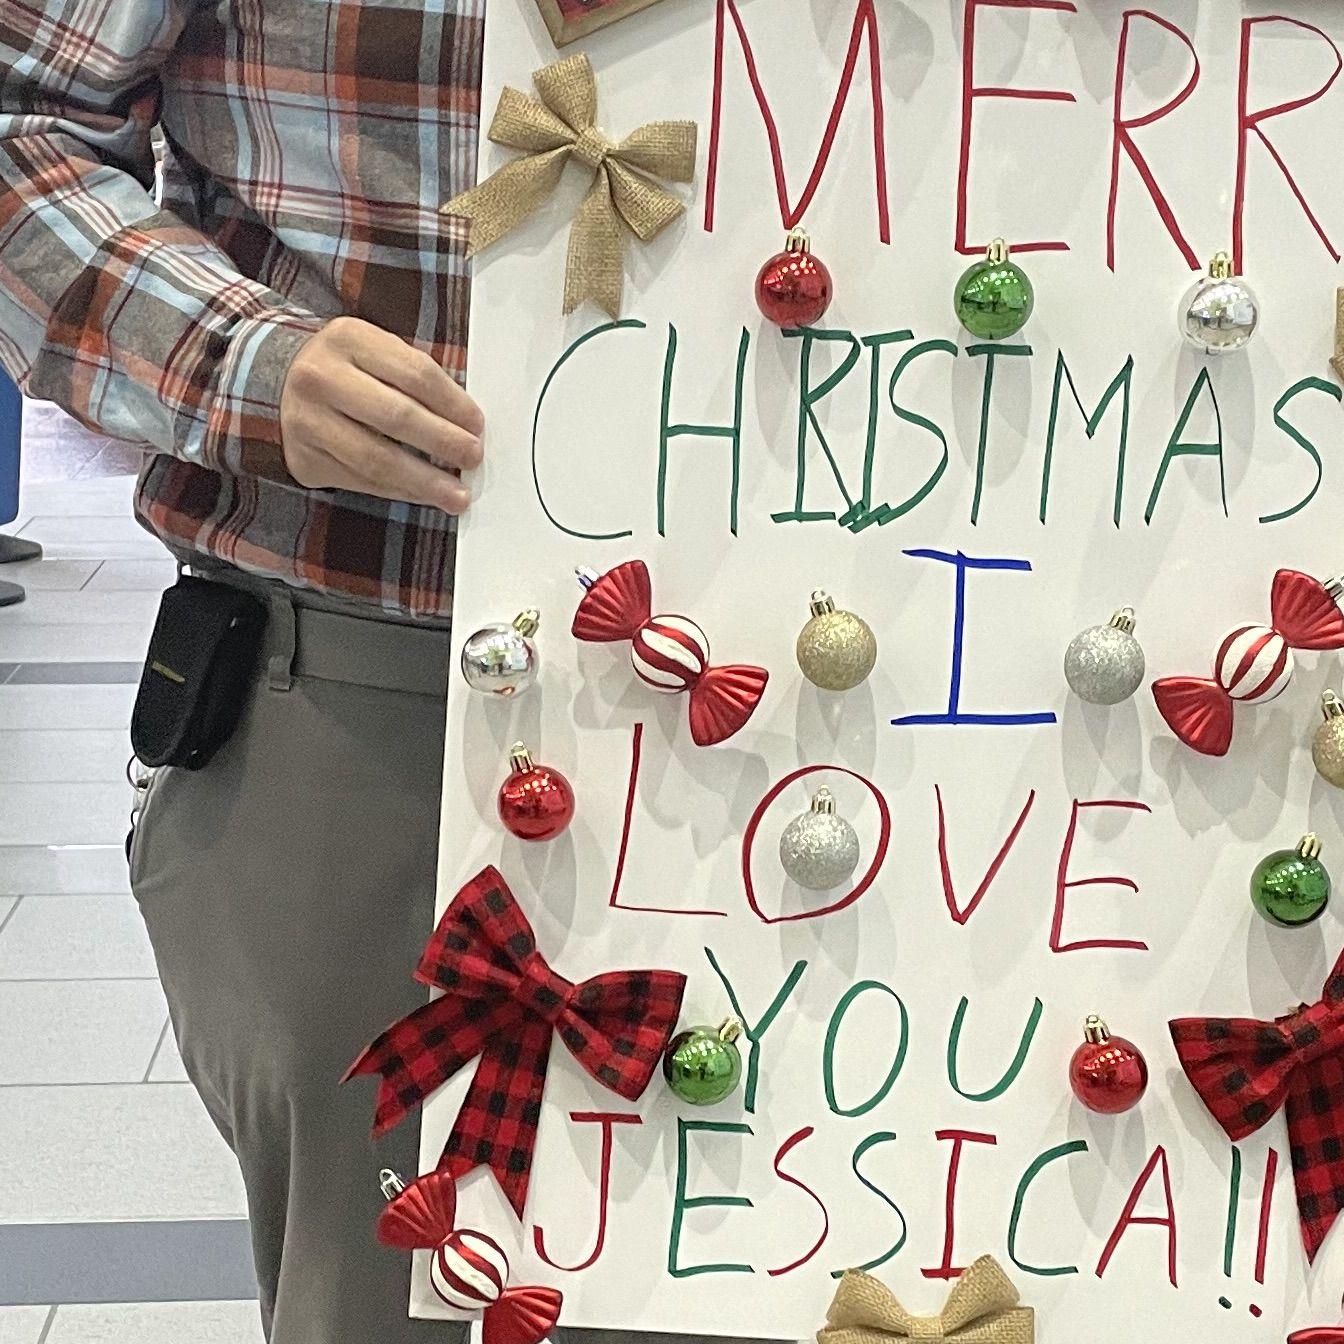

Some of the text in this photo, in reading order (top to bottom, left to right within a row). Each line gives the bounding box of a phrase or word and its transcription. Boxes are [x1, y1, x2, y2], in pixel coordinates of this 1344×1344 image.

[532, 319, 1343, 539] CHRISTMAS
[890, 548, 1057, 726] I
[609, 723, 1151, 953] LOVE
[704, 947, 1044, 1117] YOU
[532, 1111, 1280, 1317] JESSICA!!
